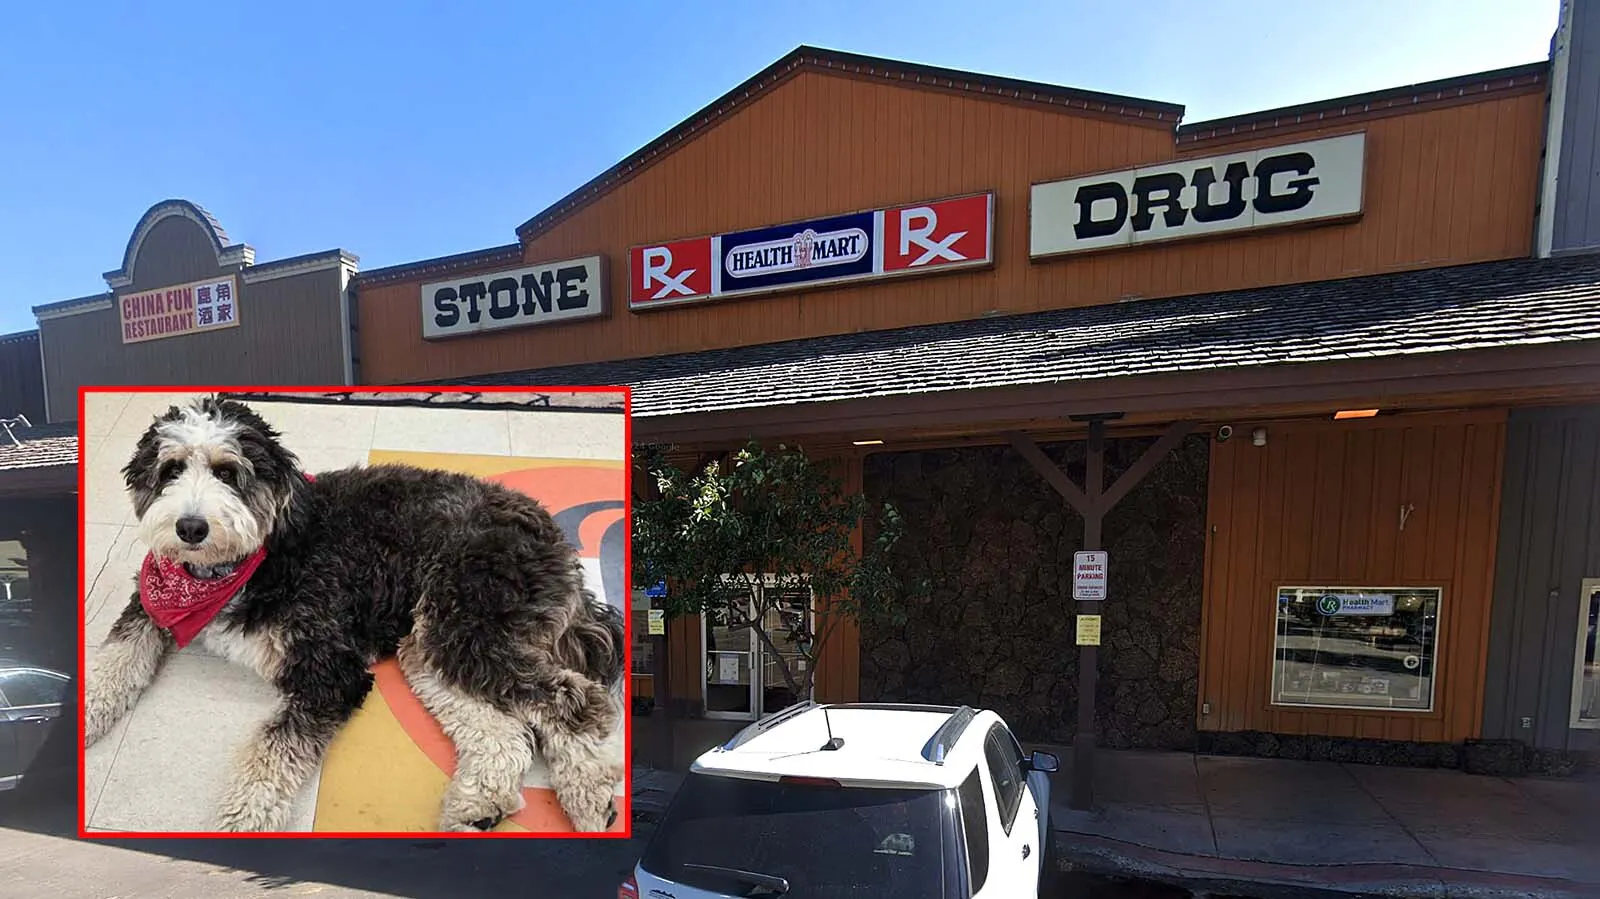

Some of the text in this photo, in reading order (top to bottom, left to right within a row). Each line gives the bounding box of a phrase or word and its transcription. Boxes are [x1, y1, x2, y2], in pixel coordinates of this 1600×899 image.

[1073, 152, 1320, 239] DRUG
[732, 233, 861, 272] HEALTH MART
[123, 288, 193, 320] CHINA FUN
[434, 265, 590, 328] STONE
[125, 312, 194, 340] RESTAURANT
[1343, 598, 1370, 606] Health
